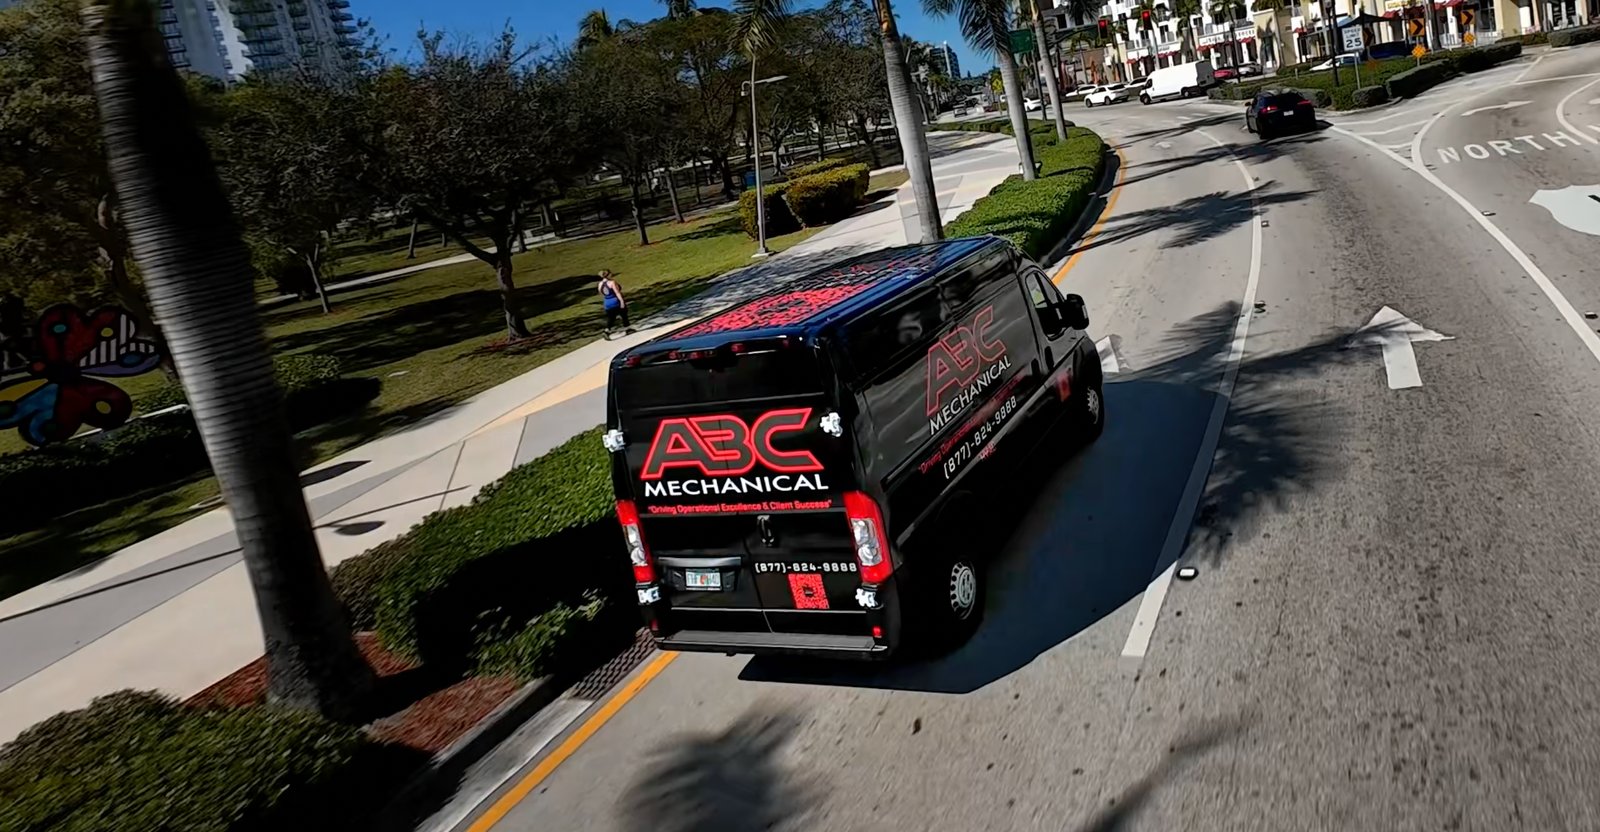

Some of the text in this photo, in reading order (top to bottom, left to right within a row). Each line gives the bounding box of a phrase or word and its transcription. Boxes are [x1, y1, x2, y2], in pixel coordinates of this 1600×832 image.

[1346, 37, 1362, 48] 25
[1436, 131, 1583, 164] NORTH
[926, 305, 1006, 417] ABC
[929, 355, 1011, 436] MECHANICAL
[641, 407, 824, 480] ABC
[943, 395, 1017, 479] (877)-824-9888
[644, 473, 829, 497] MECHANICAL
[678, 504, 720, 514] Operational
[721, 503, 762, 512] Excellence
[763, 502, 769, 510] &
[770, 501, 793, 510] Client
[754, 562, 857, 574] (877)-824-9888
